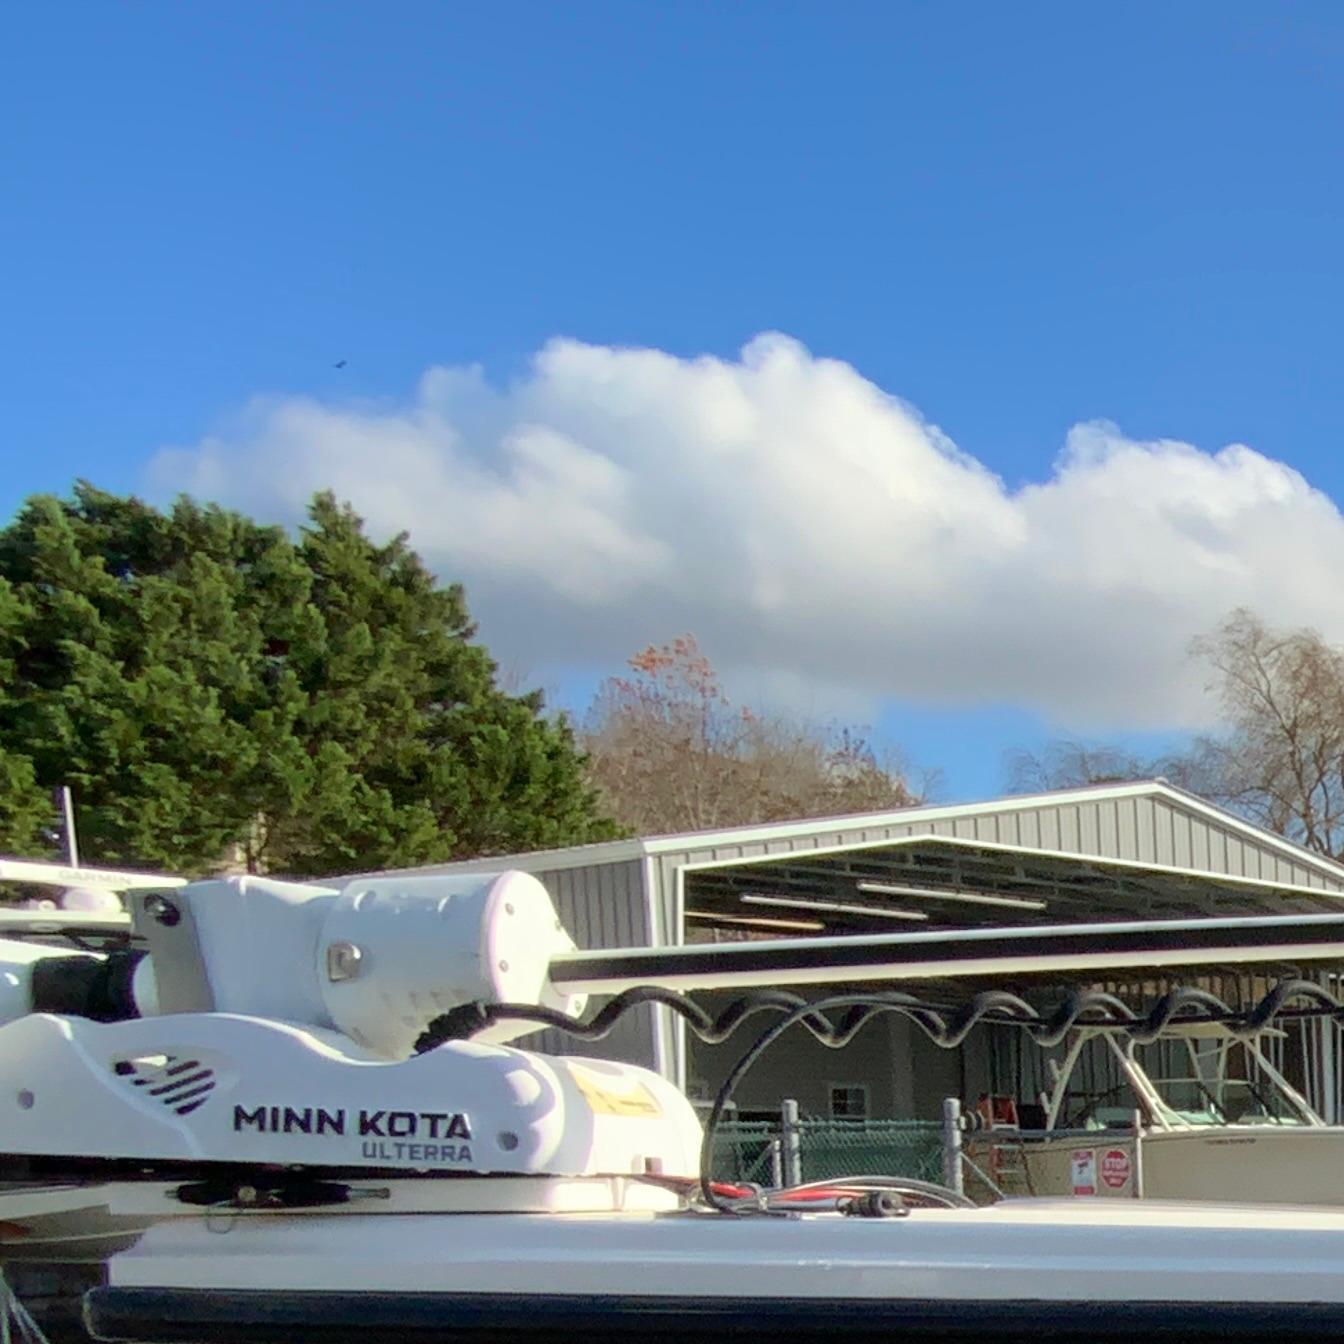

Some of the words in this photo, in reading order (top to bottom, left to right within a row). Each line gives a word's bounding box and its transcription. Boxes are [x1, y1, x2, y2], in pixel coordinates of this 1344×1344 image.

[233, 1105, 346, 1137] MINN
[358, 1109, 473, 1141] KOTA
[361, 1141, 473, 1163] ULTERRA
